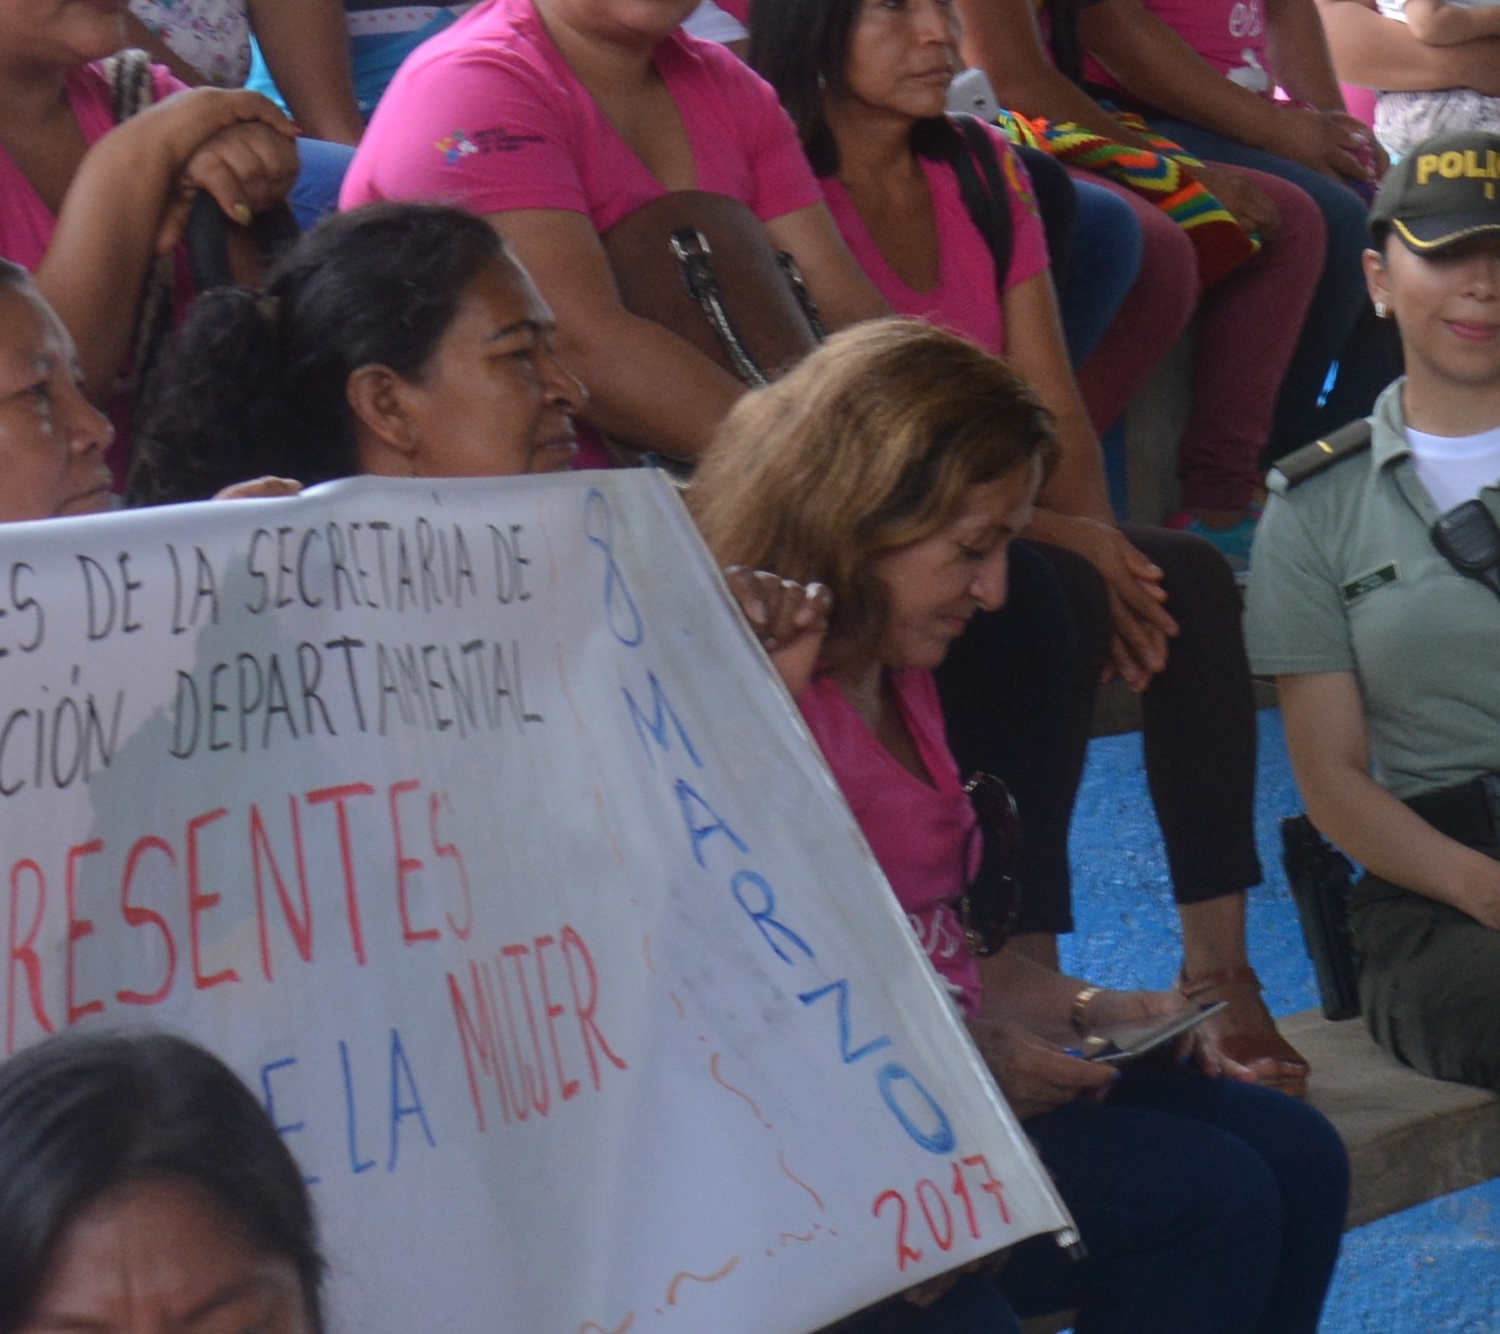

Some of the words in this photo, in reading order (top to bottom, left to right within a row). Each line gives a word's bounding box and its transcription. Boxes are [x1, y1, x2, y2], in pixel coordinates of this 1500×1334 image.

[75, 551, 144, 640] DE
[165, 542, 220, 636] LA
[487, 523, 533, 605] DE
[169, 634, 545, 760] DEPARTAMENTAL
[584, 487, 643, 648] 8
[620, 669, 958, 1157] MARZO
[339, 1027, 437, 1175] LA
[448, 925, 629, 1133] MUJER
[873, 1153, 1014, 1272] 2017
